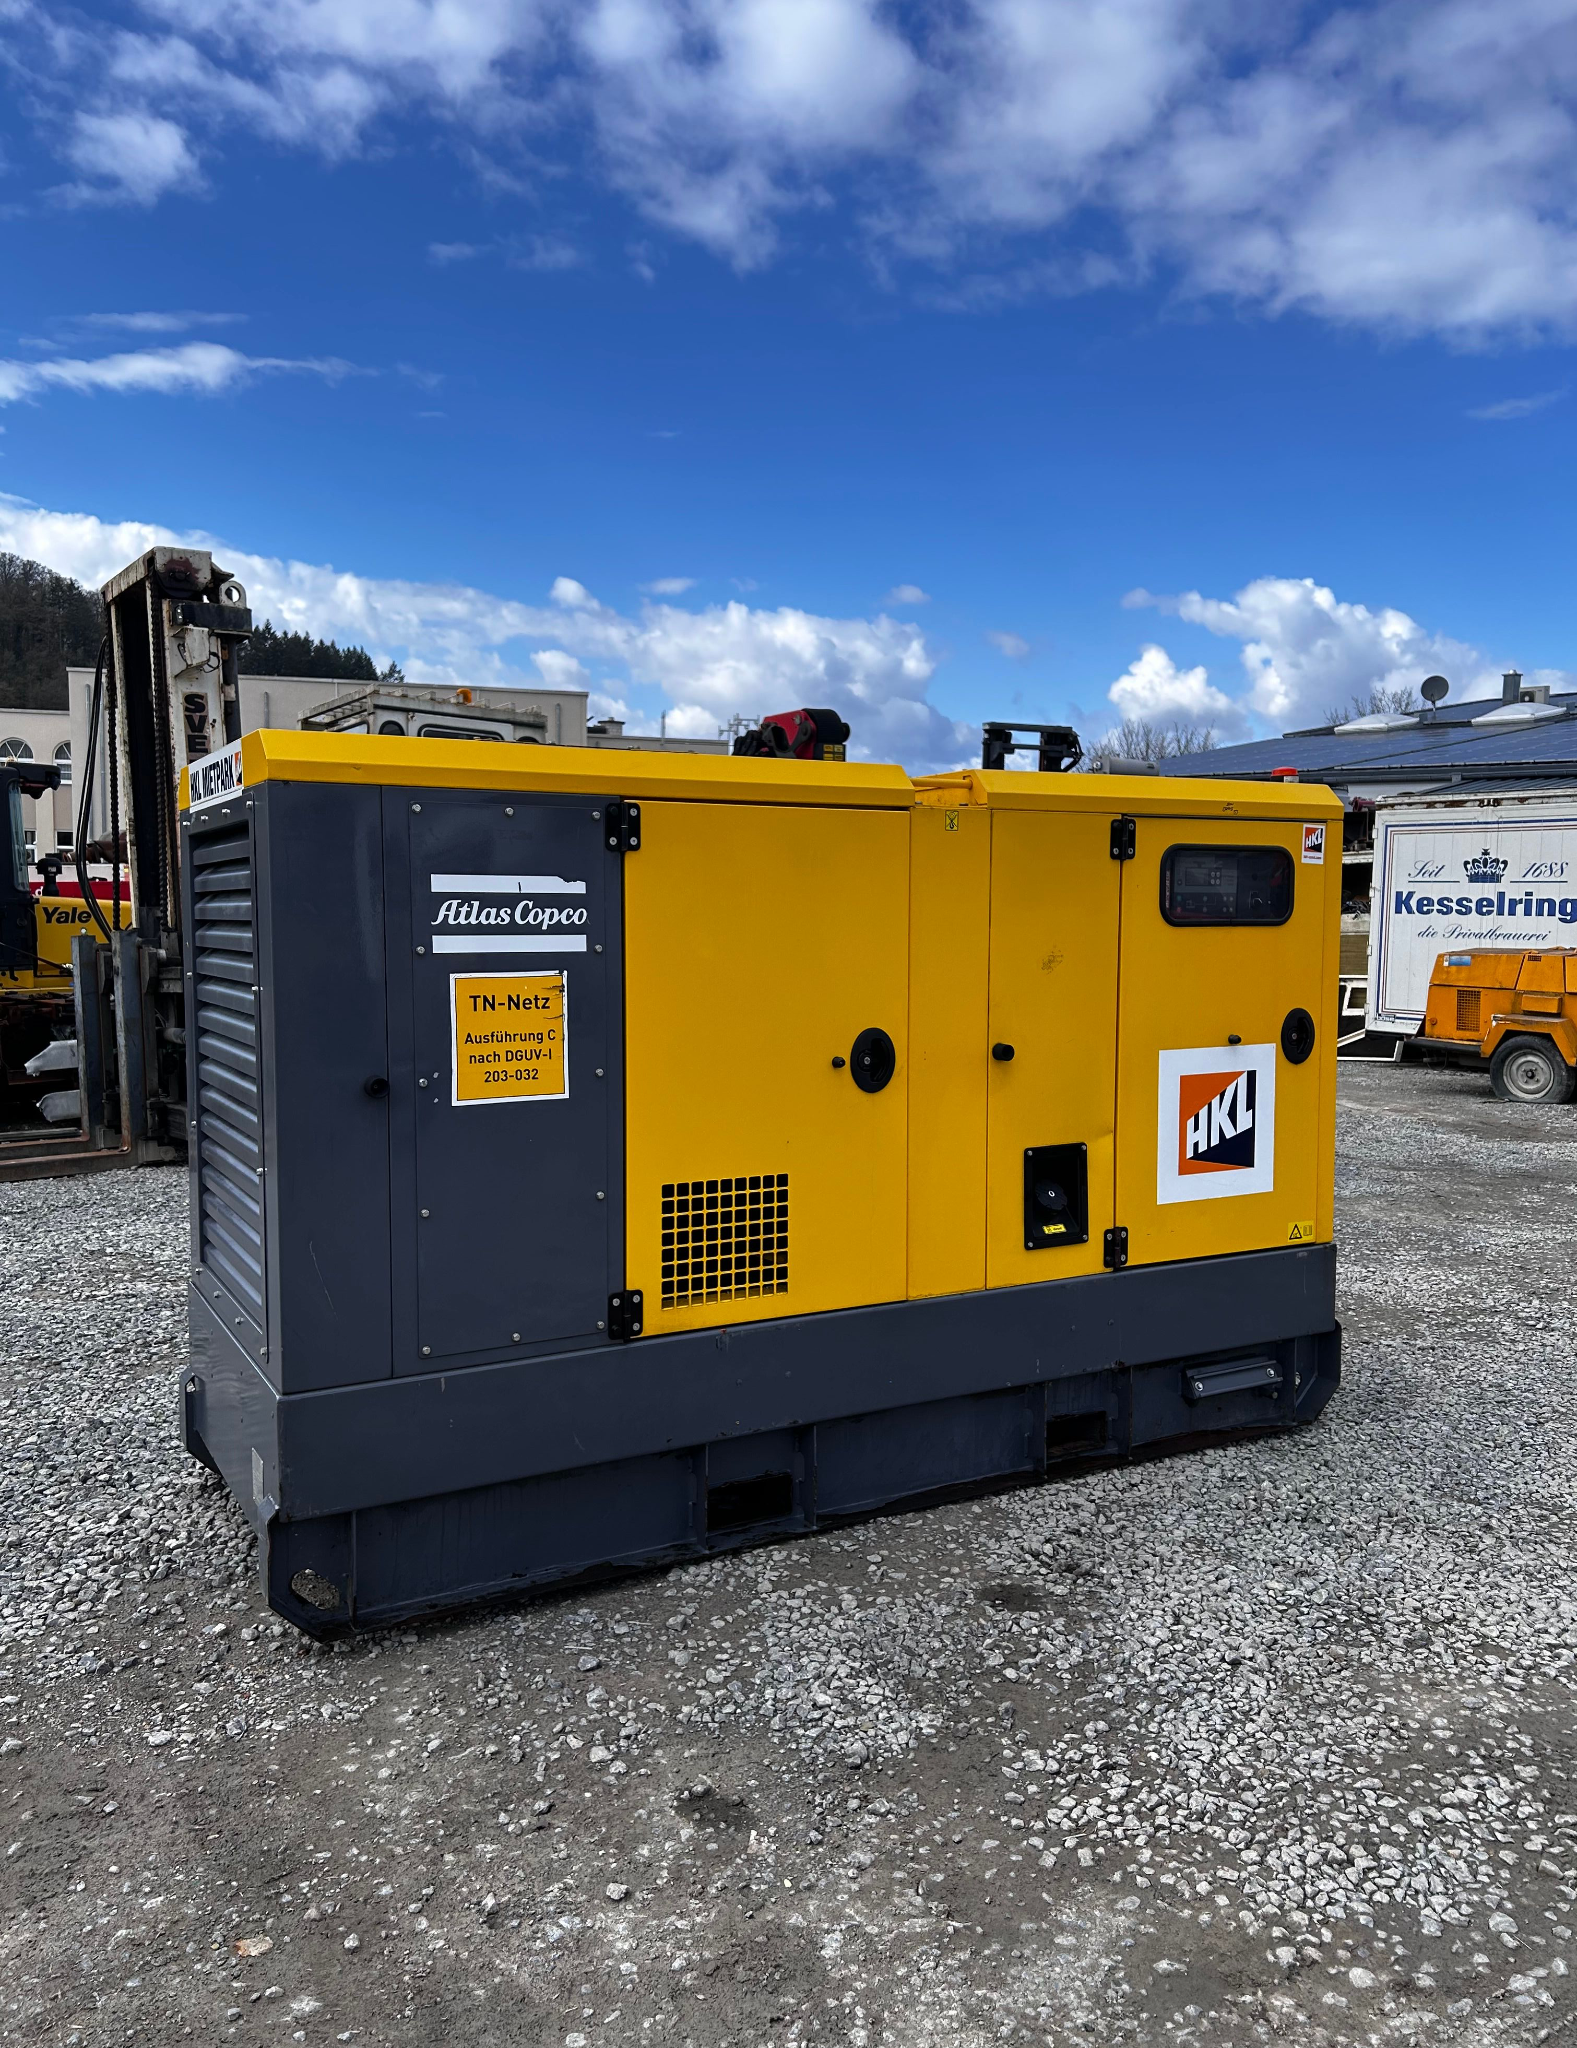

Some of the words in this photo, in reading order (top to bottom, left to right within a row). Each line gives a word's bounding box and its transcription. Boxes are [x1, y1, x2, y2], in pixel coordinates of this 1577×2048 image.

[184, 693, 209, 765] SVE
[202, 754, 235, 798] MIETPARK
[1306, 828, 1323, 848] HKL
[1408, 860, 1446, 878] Seit
[1521, 861, 1569, 878] 1688
[42, 906, 92, 924] Yale
[431, 900, 511, 925] Atlas
[514, 900, 588, 930] Copco
[1394, 890, 1577, 923] Kesselring
[1417, 925, 1439, 939] die
[1442, 923, 1551, 941] Privatbrauerei
[469, 994, 550, 1012] TN-Netz
[464, 1030, 544, 1044] Ausführung
[547, 1029, 556, 1041] C
[469, 1051, 502, 1064] nach
[484, 1069, 539, 1083] 203-032
[1186, 1070, 1252, 1159] HKL
